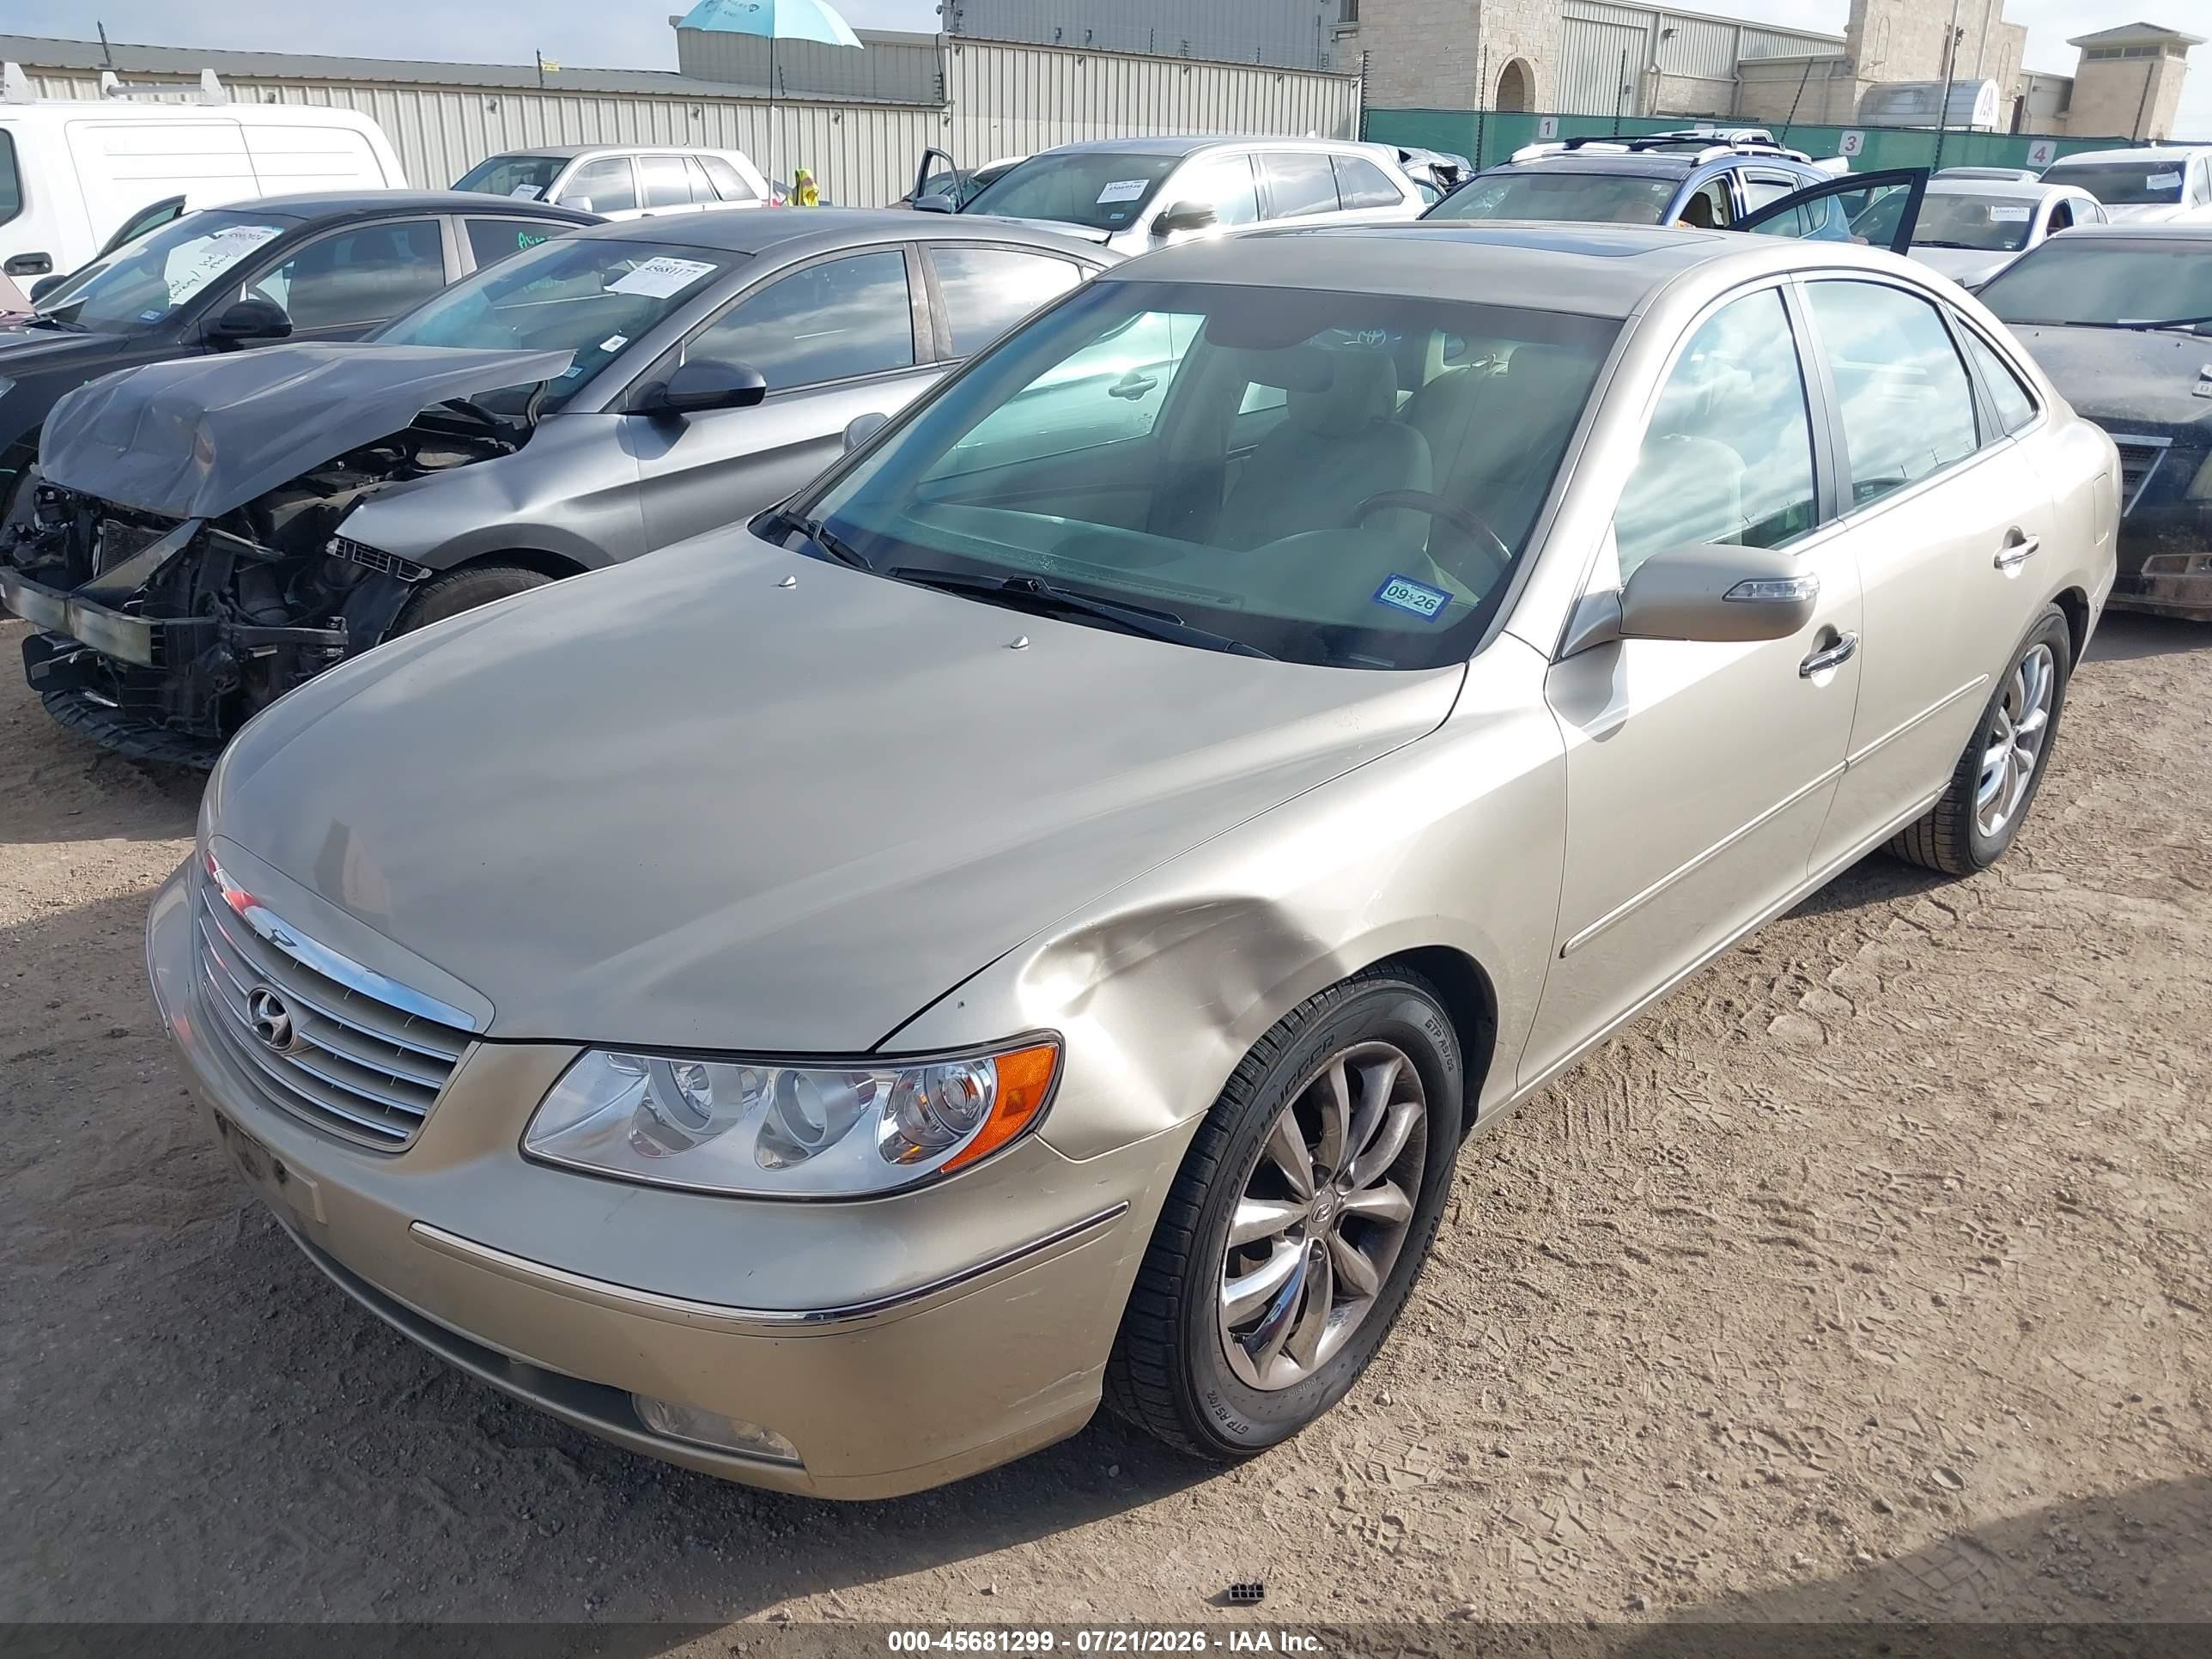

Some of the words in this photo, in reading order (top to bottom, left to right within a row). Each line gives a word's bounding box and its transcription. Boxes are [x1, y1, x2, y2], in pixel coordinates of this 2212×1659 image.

[1545, 121, 1551, 135] 1
[1844, 136, 1856, 152] 3
[2033, 146, 2046, 162] 4
[1387, 585, 1409, 600] 09
[1413, 594, 1437, 610] 26
[1425, 1018, 1443, 1038] GTP
[1261, 1032, 1335, 1133] HUGGER
[1225, 1419, 1249, 1436] GTP
